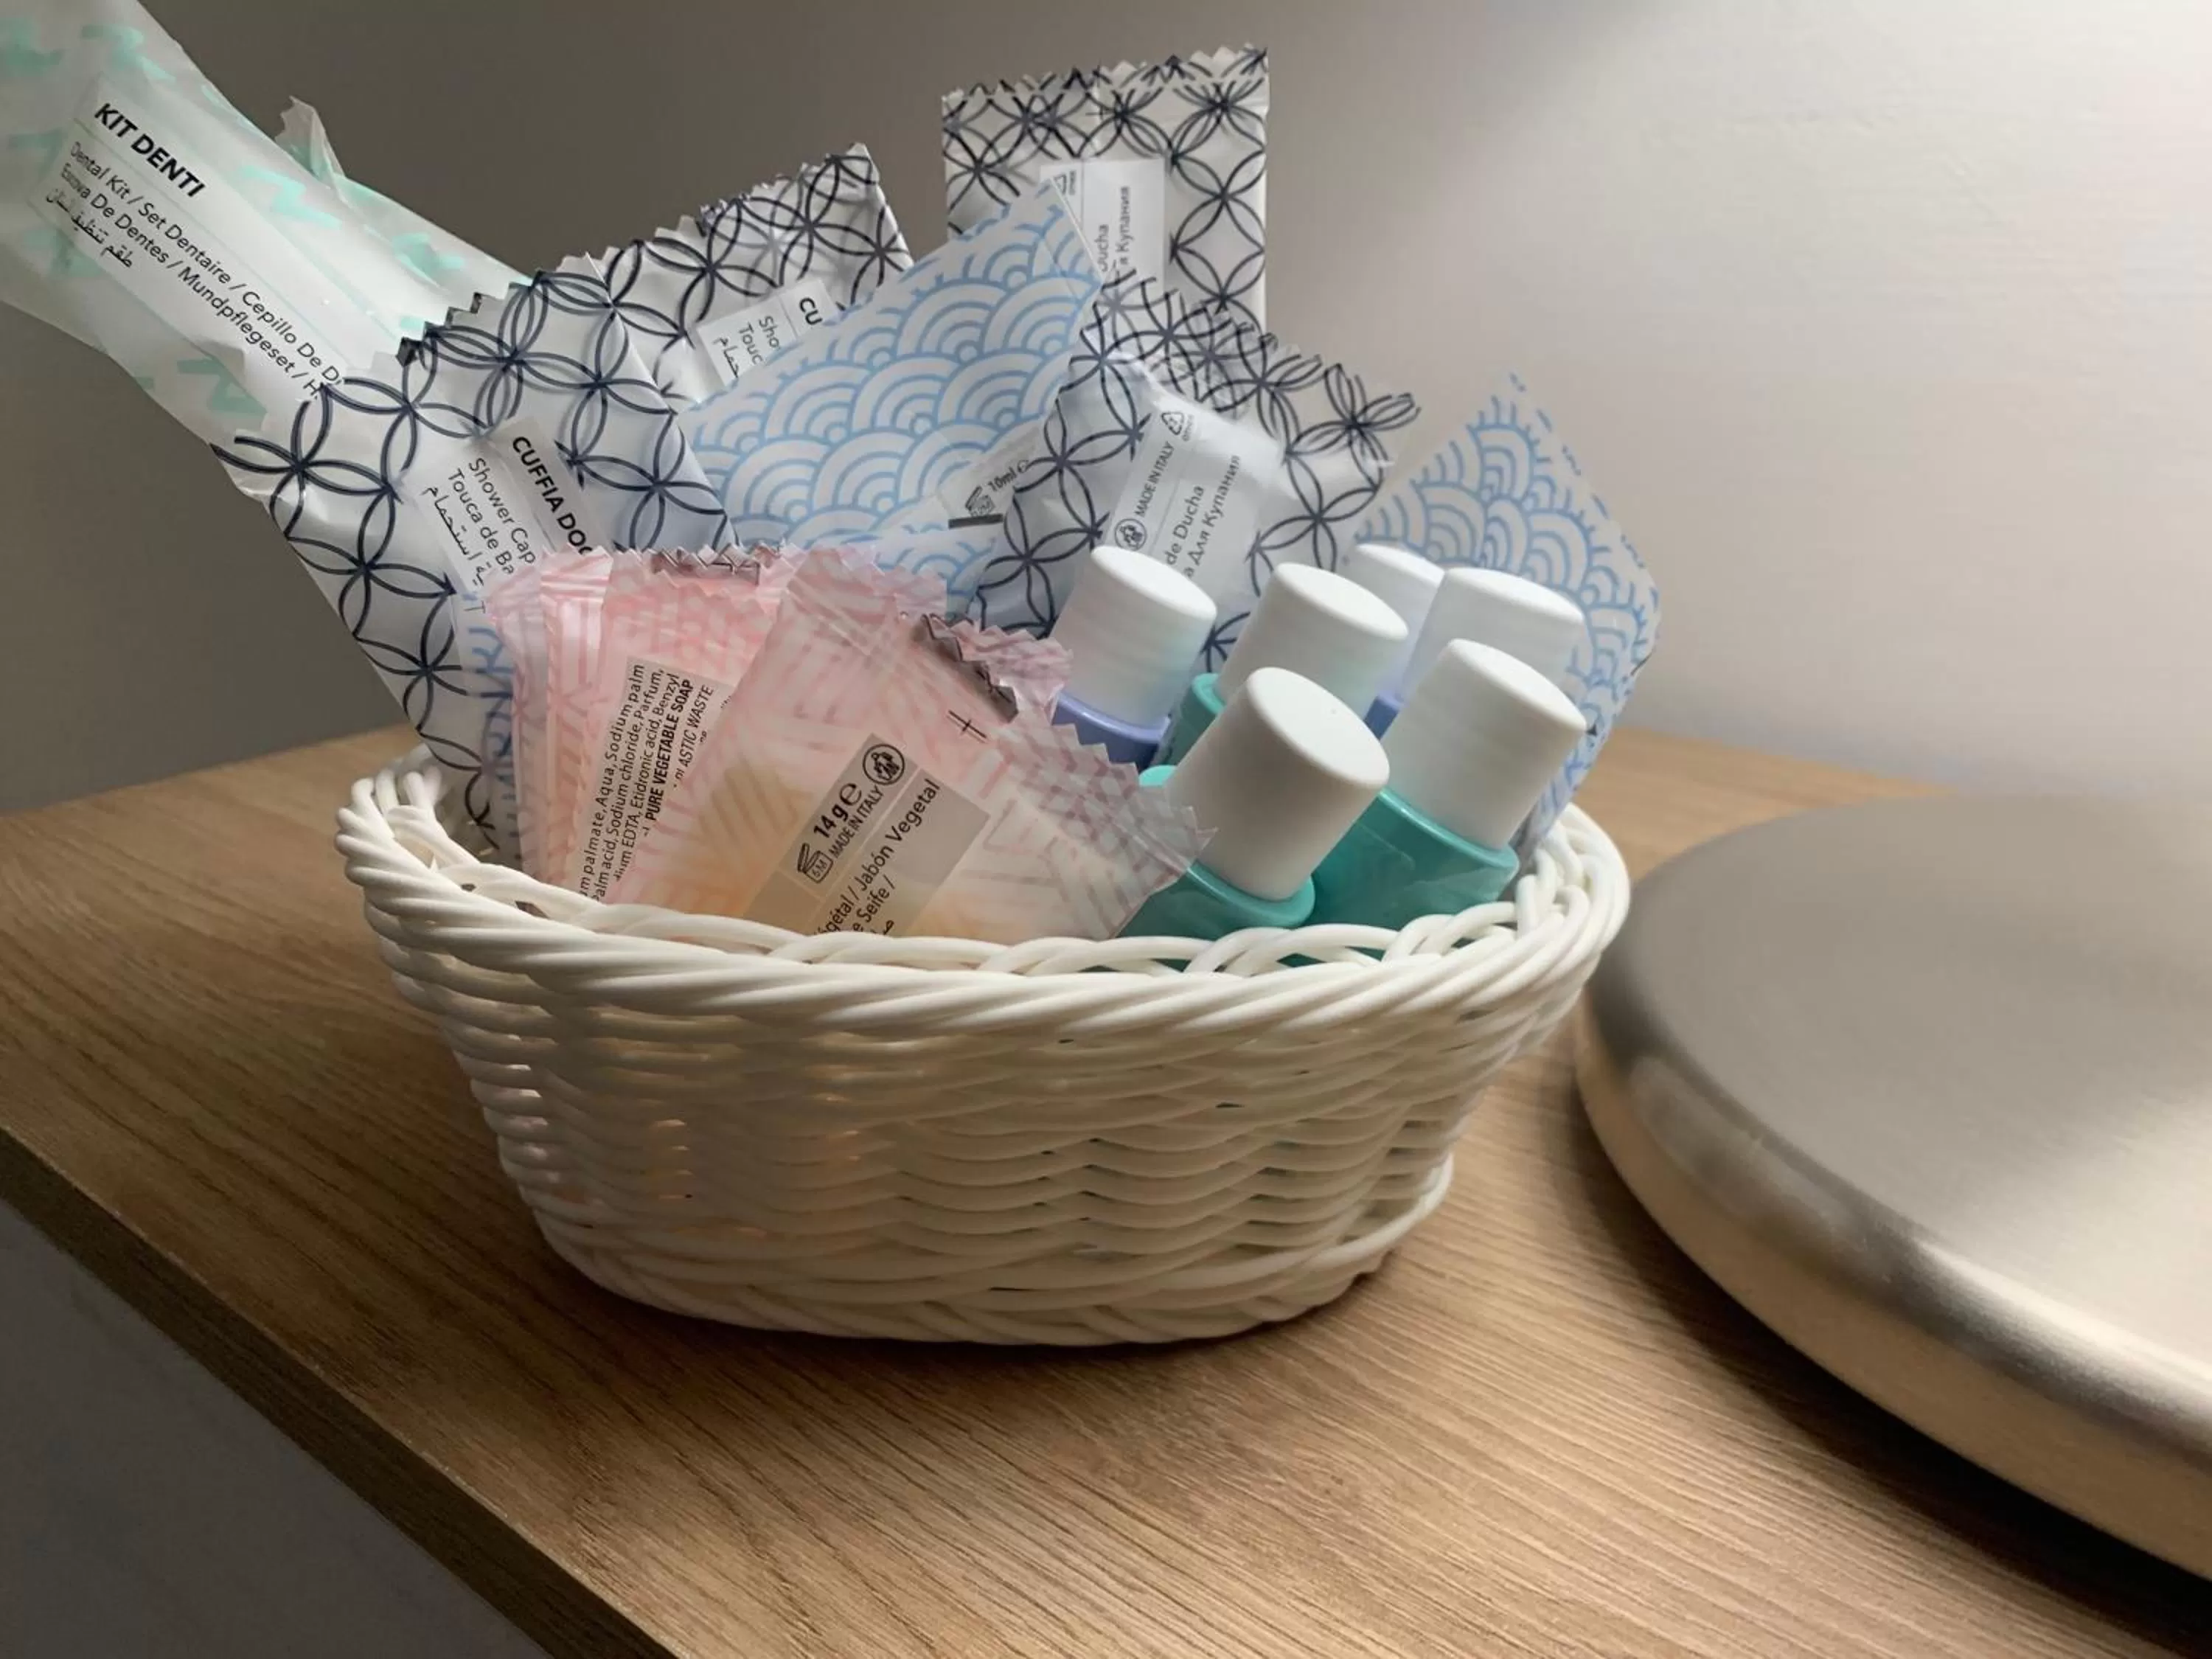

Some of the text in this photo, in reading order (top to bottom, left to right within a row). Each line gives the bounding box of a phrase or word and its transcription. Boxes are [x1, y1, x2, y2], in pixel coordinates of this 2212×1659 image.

[94, 103, 206, 198] KIT DENTI
[71, 142, 111, 179] Dental
[106, 175, 131, 199] Kit
[138, 203, 167, 230] Set
[164, 224, 231, 283] Dentaire
[243, 291, 296, 344] Cepillo
[297, 342, 322, 367] De
[321, 366, 342, 385] D
[91, 193, 115, 218] De
[114, 214, 170, 263] Dentes
[178, 266, 296, 373] Mundpflegeset
[303, 379, 323, 397] H
[759, 316, 780, 349] Sho
[799, 297, 823, 325] CU
[448, 468, 484, 523] Touca
[480, 526, 499, 549] de
[469, 458, 515, 525] Shower
[511, 526, 536, 565] Cap
[512, 437, 564, 513] CUFFIA
[1134, 441, 1175, 518] MADE IN ITALY
[1187, 530, 1211, 566] Для
[1202, 455, 1240, 527] Купания
[1164, 485, 1205, 565] de Ducha
[605, 704, 633, 762] Sodium
[628, 664, 645, 703] palm
[630, 749, 653, 809] Etidronic
[652, 672, 680, 716] Benzyl
[687, 684, 714, 728] WASTE
[645, 679, 693, 821] PURE VEGETABLE SOAP
[606, 784, 629, 836] Sodium
[829, 785, 884, 859] MADE IN ITALY
[854, 846, 894, 891] Jabón
[886, 778, 940, 842] Vegetal
[856, 887, 890, 923] Seife
